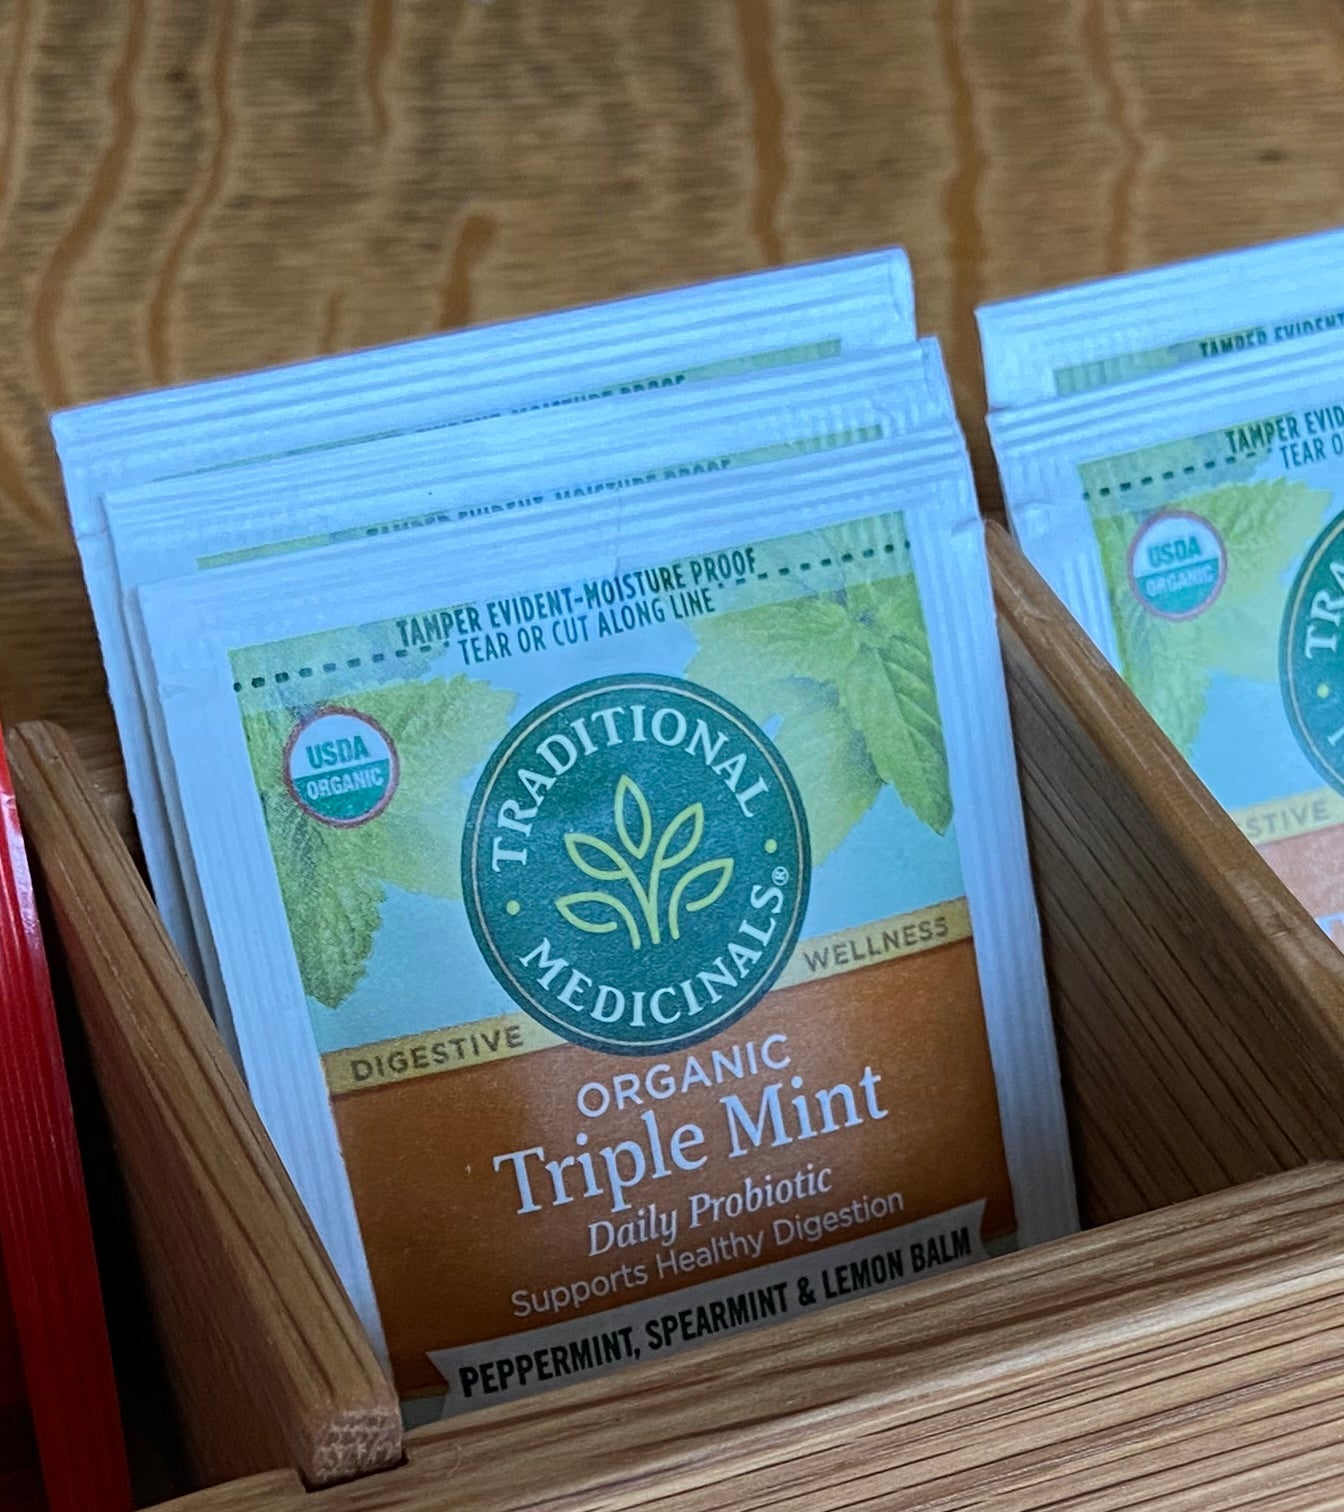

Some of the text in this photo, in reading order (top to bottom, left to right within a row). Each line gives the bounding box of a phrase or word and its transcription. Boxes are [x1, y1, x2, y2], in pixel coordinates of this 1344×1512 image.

[1224, 415, 1300, 455] TAMPER
[1279, 441, 1327, 470] TEAR
[1145, 563, 1215, 598] ORGANIC
[1147, 536, 1202, 568] USDA
[396, 609, 483, 648] TAMPER
[689, 547, 757, 586] PROOF
[457, 588, 716, 667] TEAR OR CUT ALONG LINE
[306, 735, 369, 769] USDA
[306, 767, 384, 800] ORGANIC
[491, 705, 772, 874] TRADITIONAL
[803, 916, 950, 973] WELLNESS
[349, 1025, 525, 1083] DIGESTIVE
[576, 1034, 792, 1119] ORGANIC
[493, 1064, 890, 1215] Triple Mint
[586, 1163, 833, 1258] Daily Probiotic
[510, 1190, 905, 1319] Supports Healthy Digestion
[458, 1226, 972, 1398] PEPPERMINT, SPEARMINT & LEMON BALM
